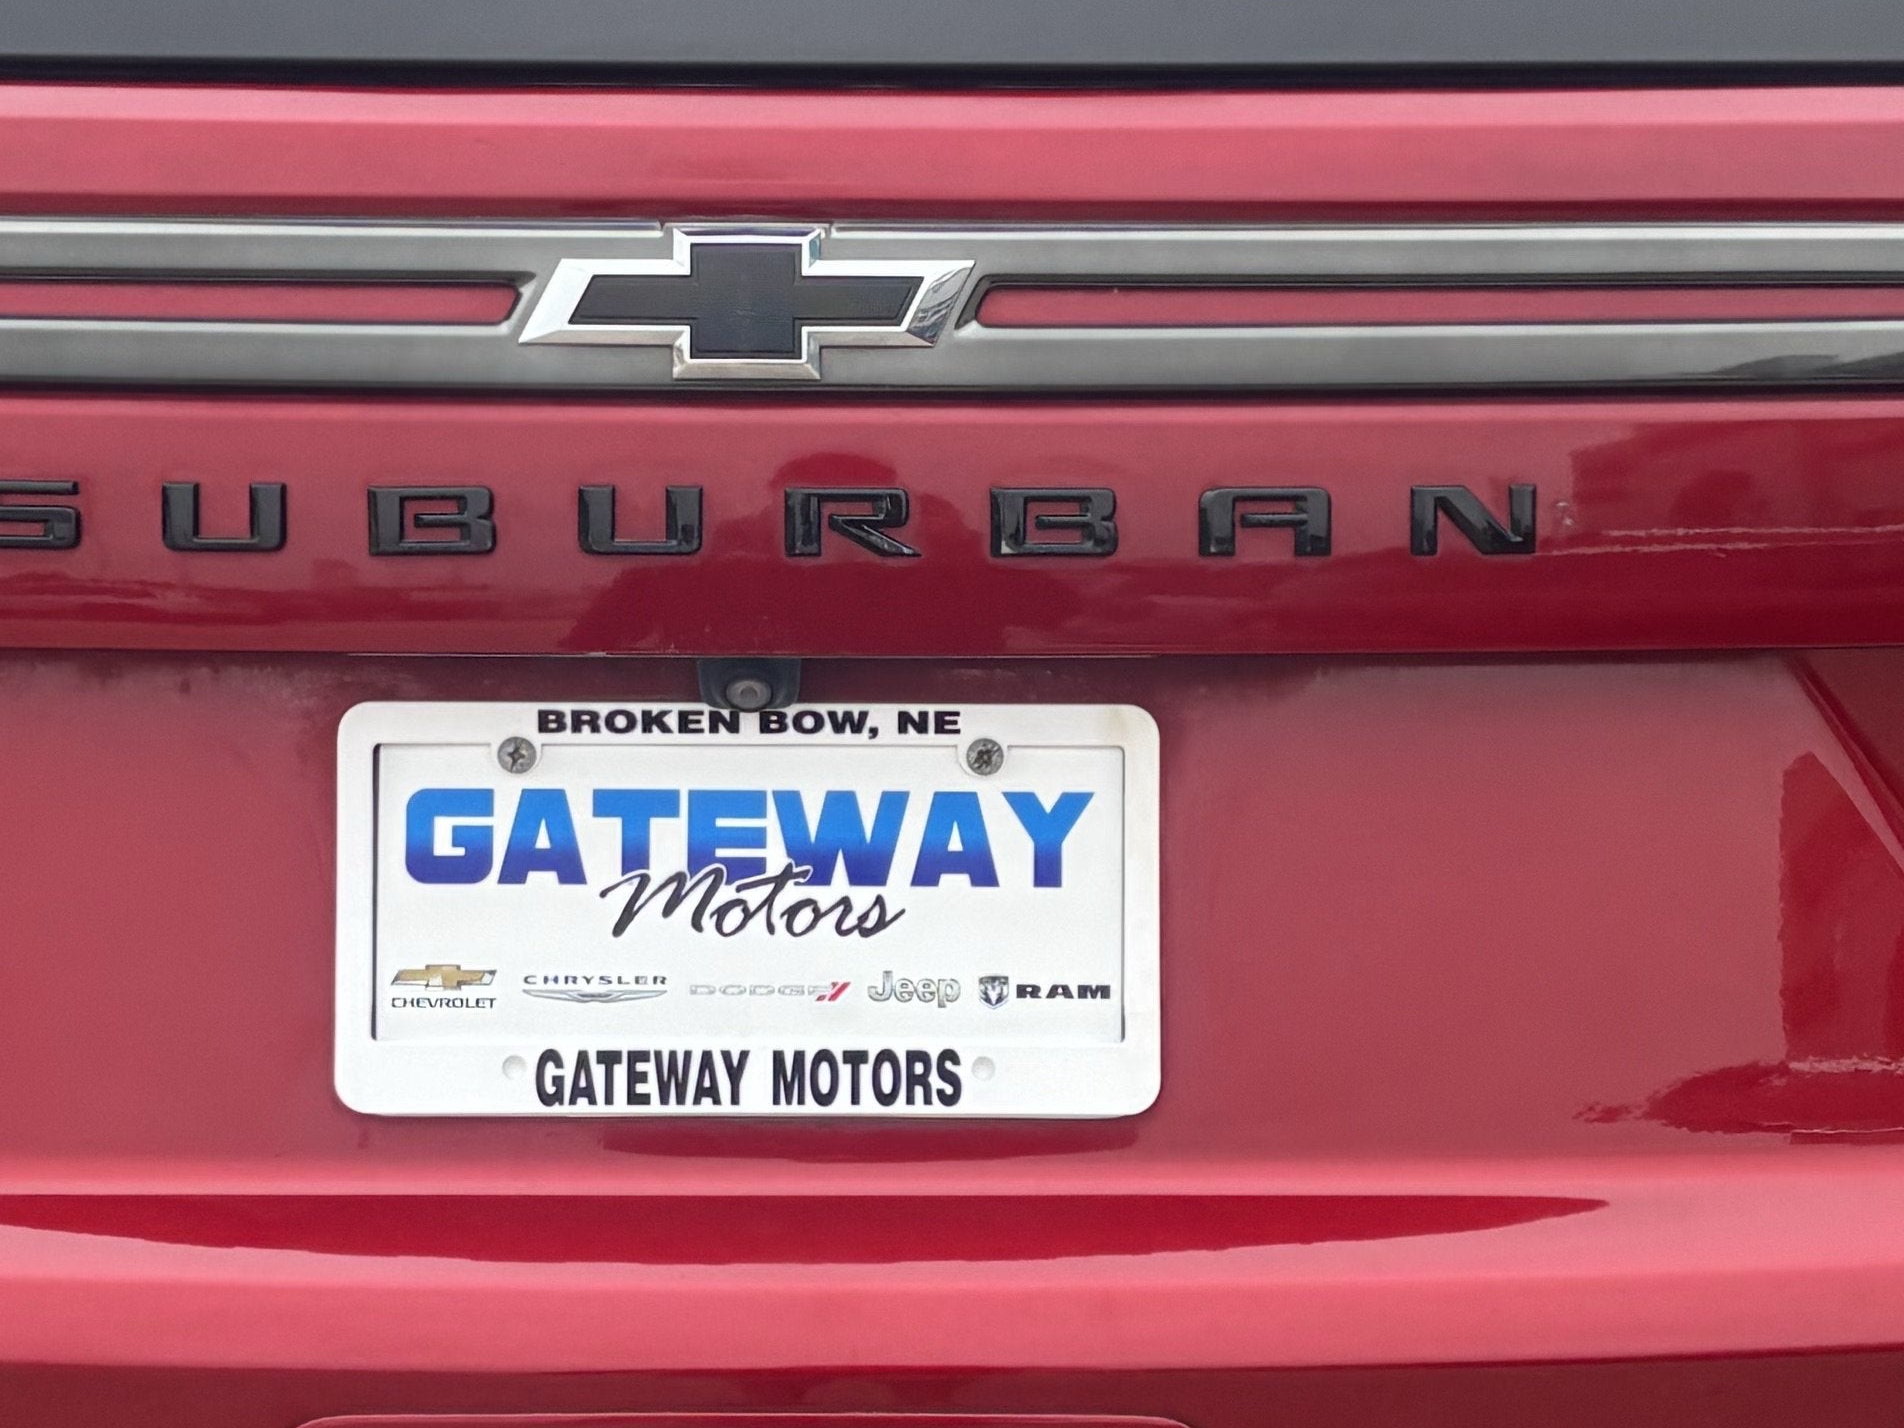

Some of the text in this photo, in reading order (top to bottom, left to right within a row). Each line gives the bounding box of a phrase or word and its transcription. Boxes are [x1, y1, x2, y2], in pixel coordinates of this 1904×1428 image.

[537, 710, 962, 739] BROKEN BOW, NE
[404, 787, 1096, 888] GATEWAY
[599, 861, 906, 939] Motors
[390, 970, 1112, 1009] CHEVROLET CHRYSLER DODGE Jeep RAM
[535, 1048, 963, 1108] GATEWAY MOTORS
